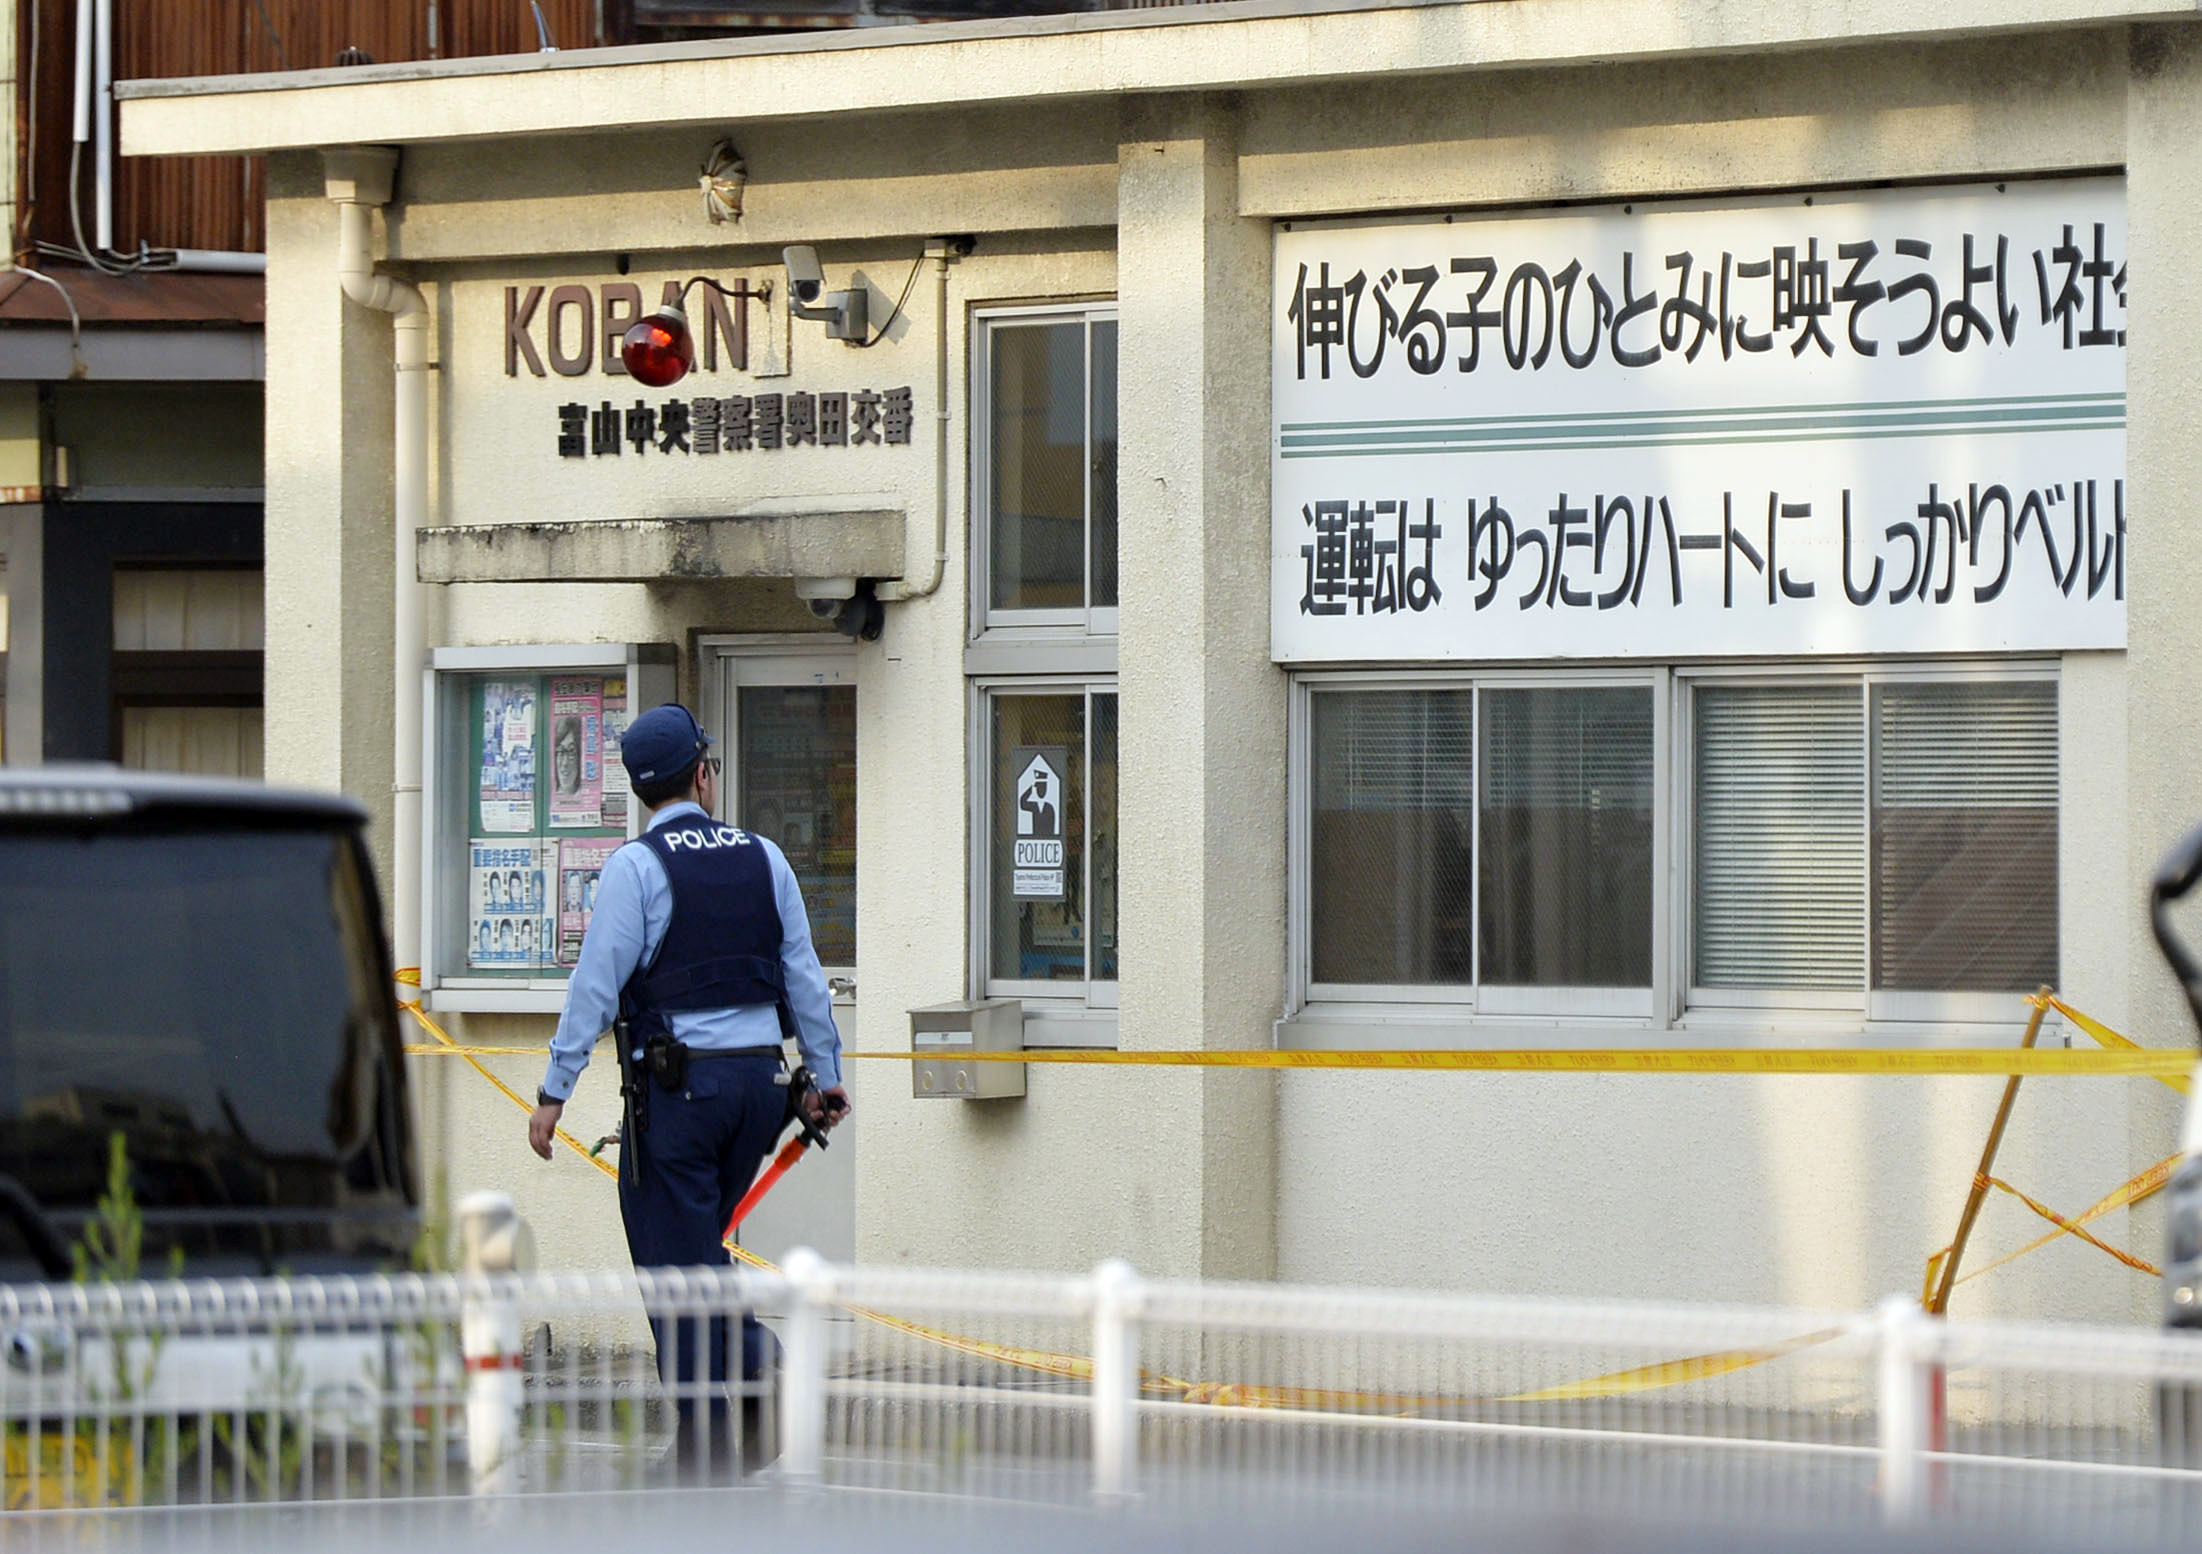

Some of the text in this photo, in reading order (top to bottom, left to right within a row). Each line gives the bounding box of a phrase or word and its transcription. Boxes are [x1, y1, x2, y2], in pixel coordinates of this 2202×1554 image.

[557, 385, 914, 459] 富山中央警察署奥田交番
[1300, 497, 1442, 617] 運転は
[1467, 488, 1816, 612] ゆったりハートに
[664, 827, 751, 852] POLICE
[1018, 843, 1060, 864] POLICE
